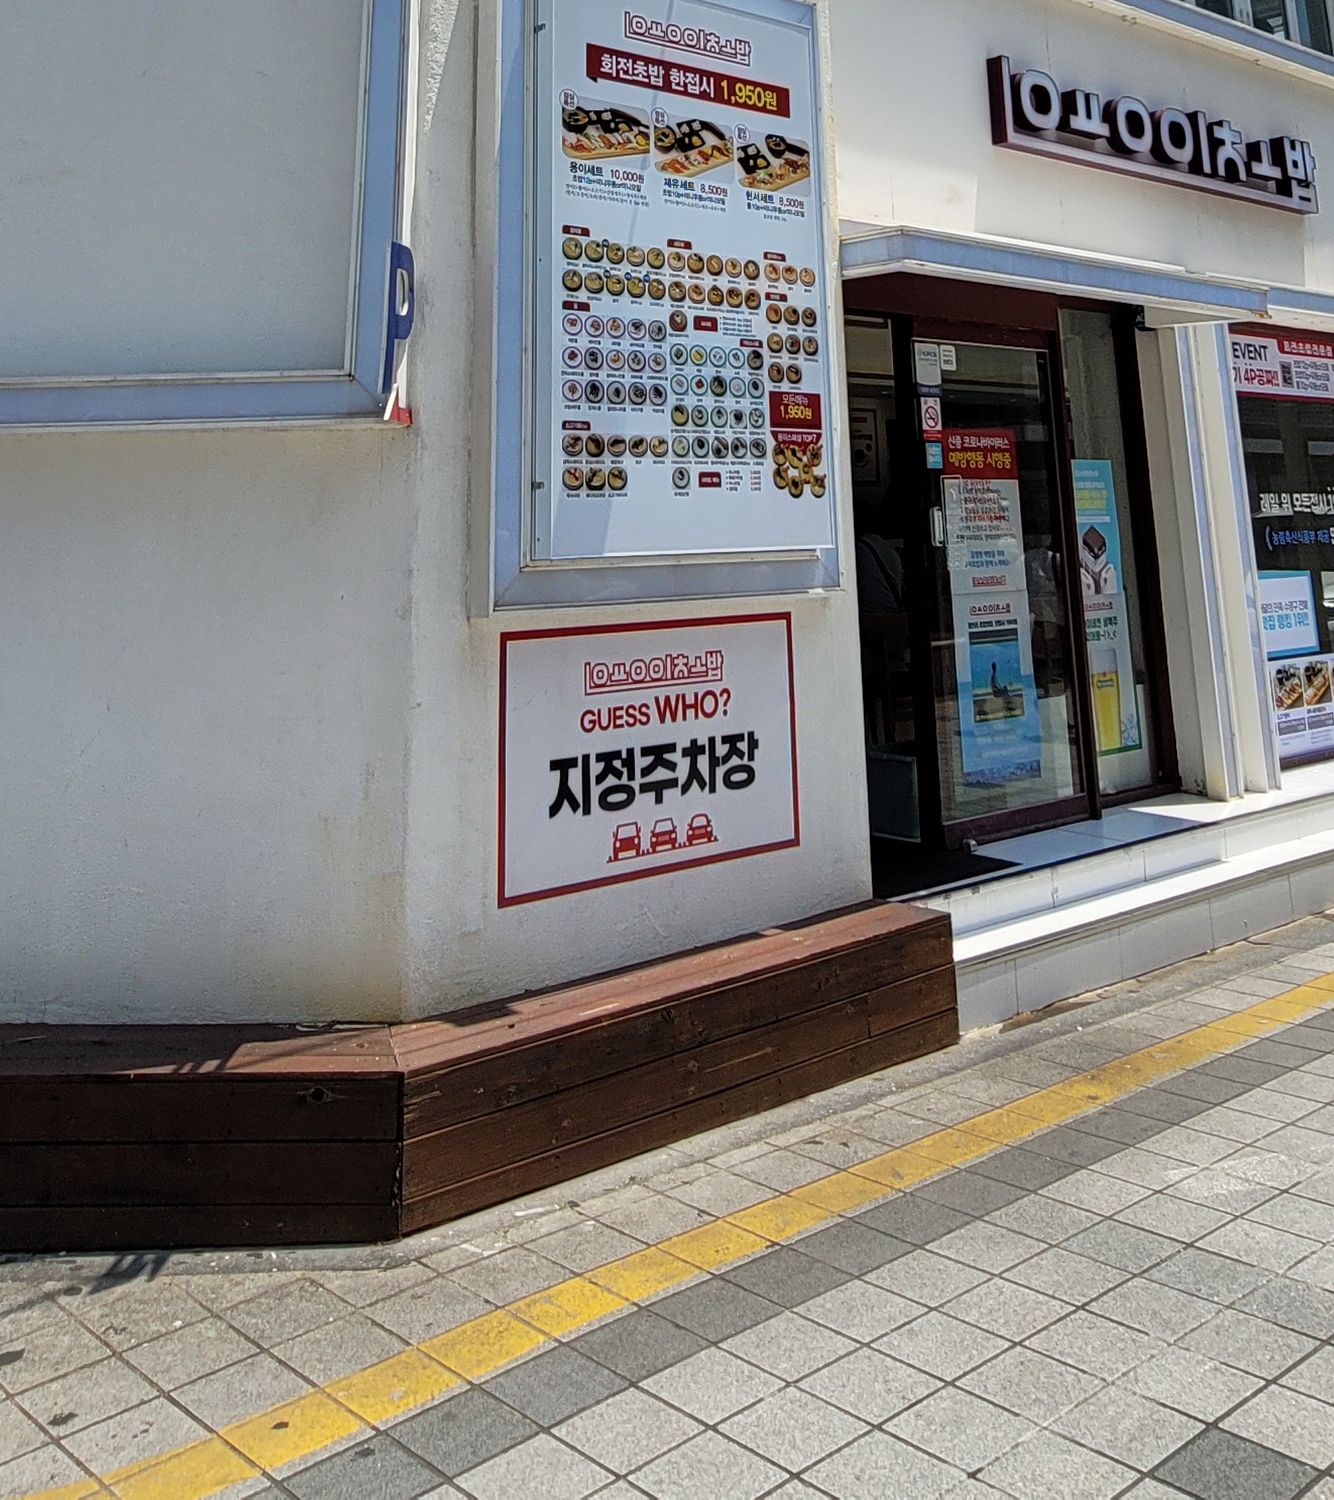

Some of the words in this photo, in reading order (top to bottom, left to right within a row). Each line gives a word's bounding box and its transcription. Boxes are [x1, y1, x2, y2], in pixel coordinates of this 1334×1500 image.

[600, 53, 664, 87] 회전초밥
[669, 68, 715, 98] 한접시
[720, 79, 778, 111] 1,950원
[569, 161, 604, 177] 용이세트
[610, 169, 644, 184] 10,000원
[700, 183, 728, 197] 8,500원
[779, 197, 804, 210] 8,500원
[1232, 341, 1268, 361] EVENT
[1283, 341, 1333, 357] 회전초밥전문점
[782, 394, 809, 405] 모든메뉴
[780, 405, 812, 419] 1,950원
[948, 435, 962, 449] 신종
[963, 436, 1010, 449] 코로나바이러스
[949, 451, 985, 468] 예방행동
[986, 451, 1011, 469] 시행중
[1259, 492, 1280, 512] 레일
[1280, 492, 1291, 512] 위
[1292, 492, 1327, 513] 모든접시
[580, 703, 651, 733] GUESS
[654, 687, 731, 725] WHO?
[548, 730, 759, 819] 지정주차장
